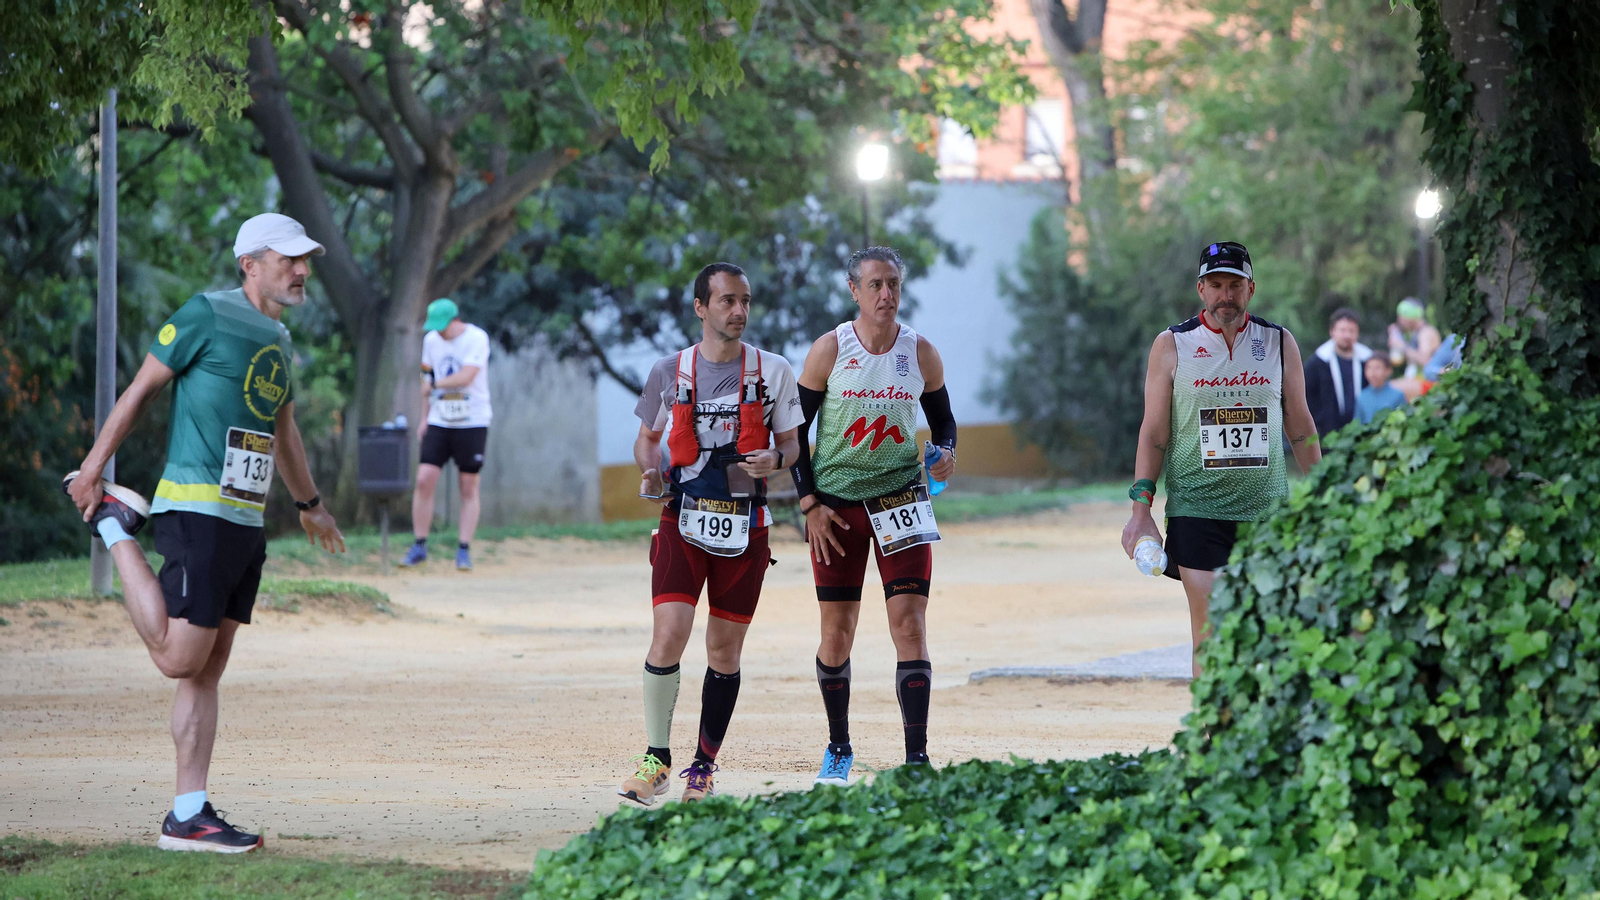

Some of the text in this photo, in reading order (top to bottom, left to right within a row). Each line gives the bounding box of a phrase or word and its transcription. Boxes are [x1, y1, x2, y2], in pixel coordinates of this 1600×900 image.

[1193, 370, 1271, 388] maratón
[841, 385, 914, 401] maratón
[1216, 390, 1250, 398] JEREZ
[1219, 408, 1251, 422] Sherry
[1218, 427, 1253, 449] 137
[243, 455, 269, 482] 133
[697, 514, 733, 539] 199
[889, 506, 922, 530] 181
